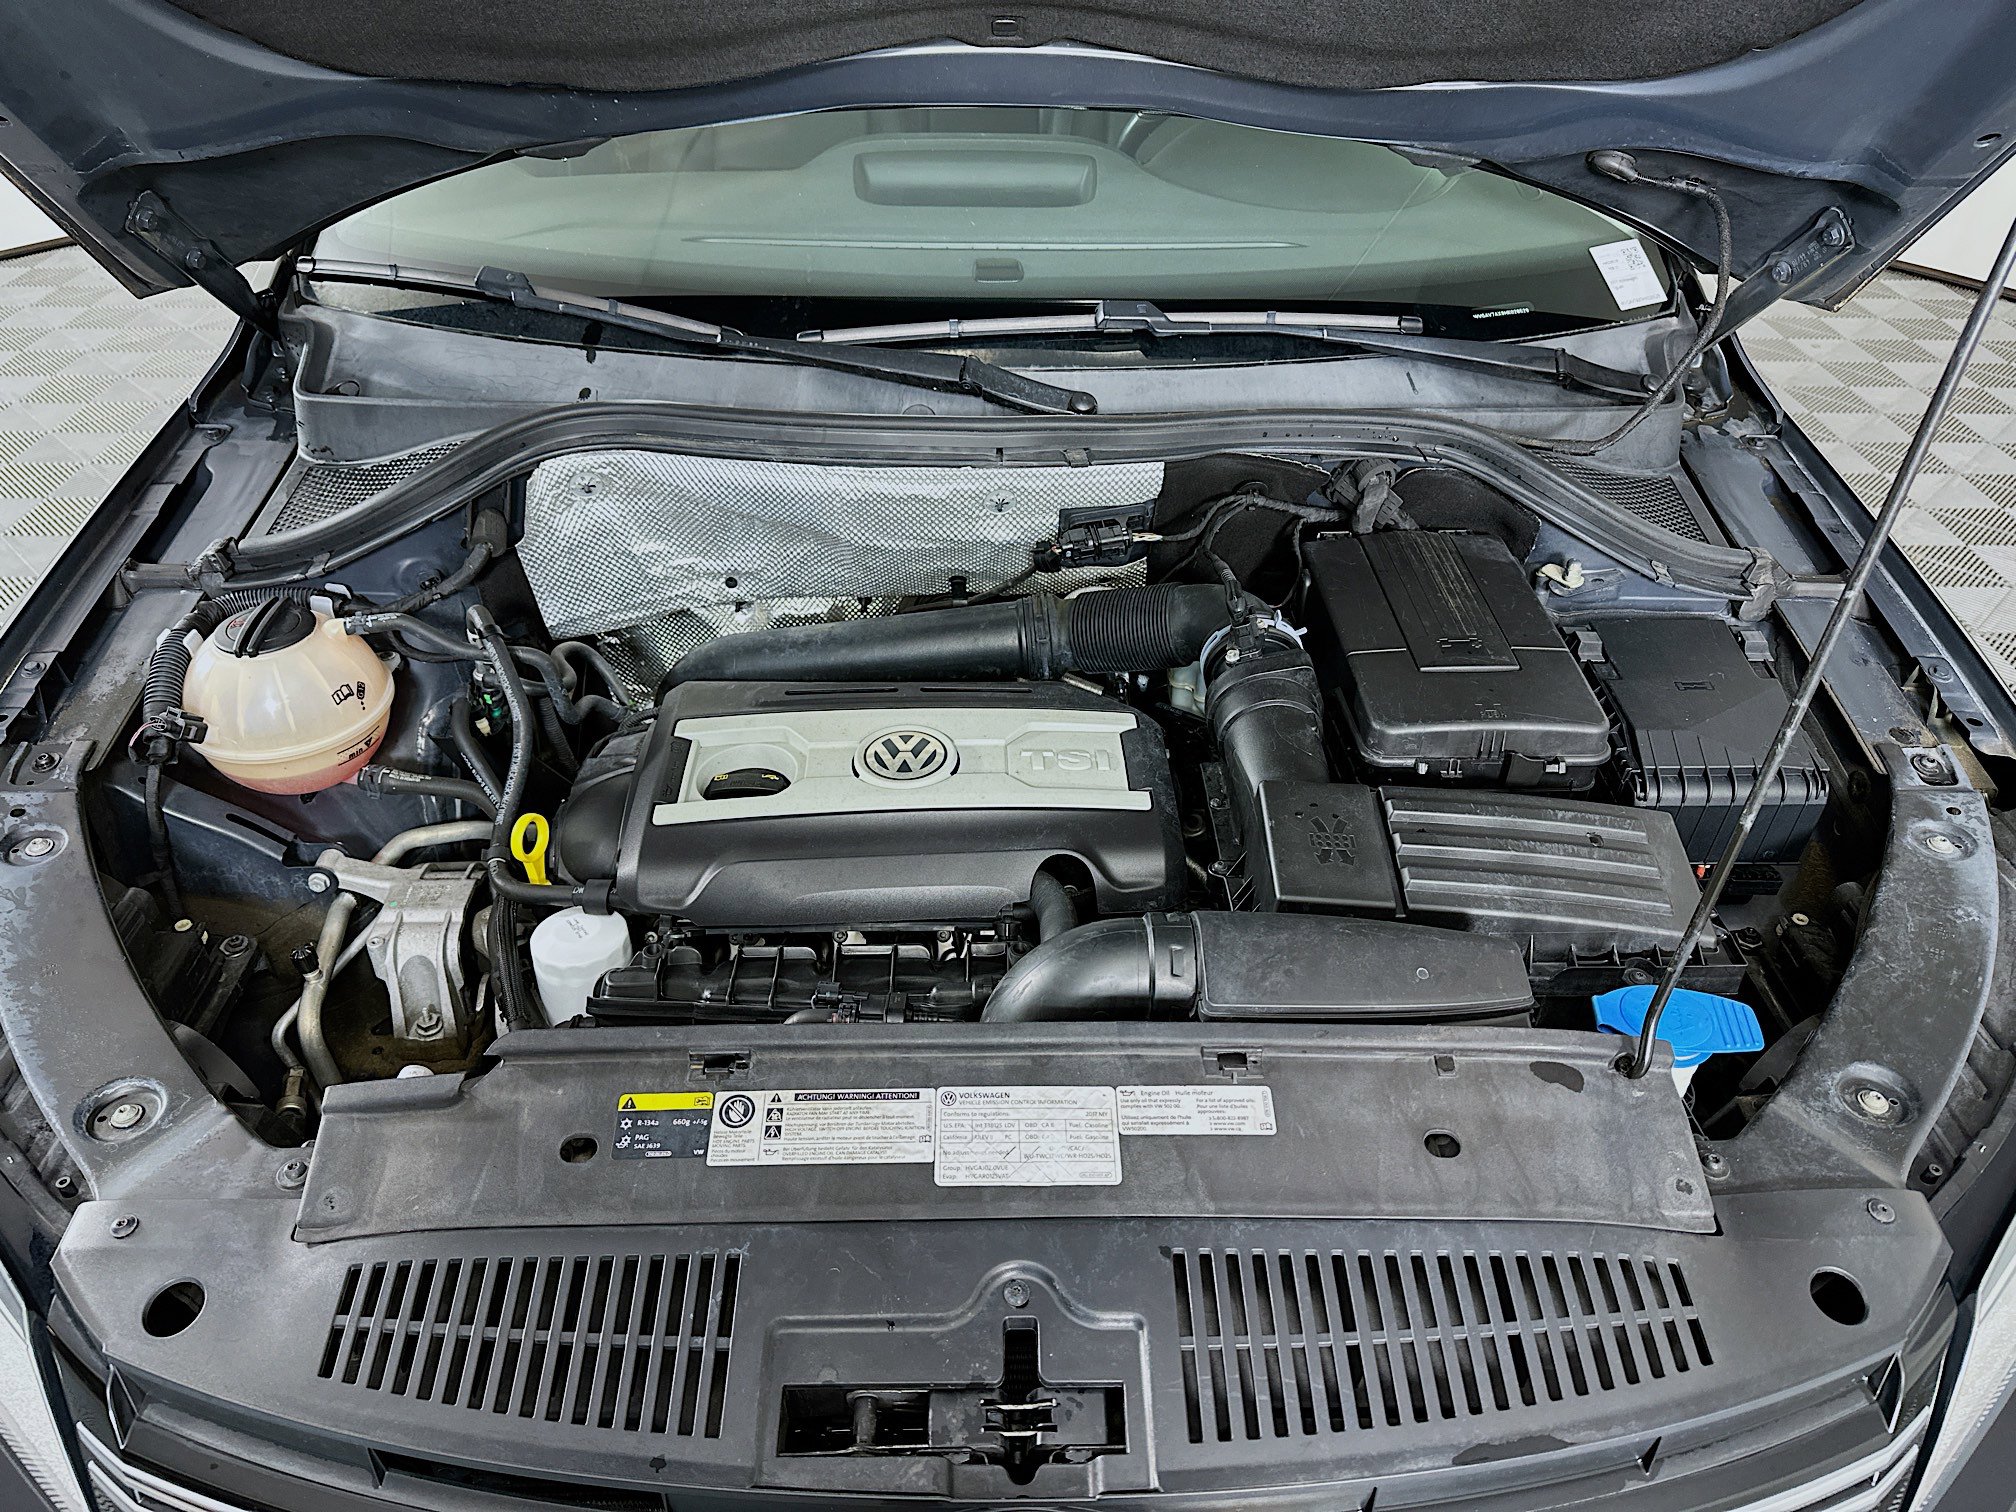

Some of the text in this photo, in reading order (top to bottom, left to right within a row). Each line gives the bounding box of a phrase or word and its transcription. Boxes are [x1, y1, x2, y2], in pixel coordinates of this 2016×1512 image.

[348, 747, 364, 760] min
[1020, 748, 1111, 771] TSI
[672, 1118, 691, 1127] 660g
[634, 1133, 650, 1141] PAG
